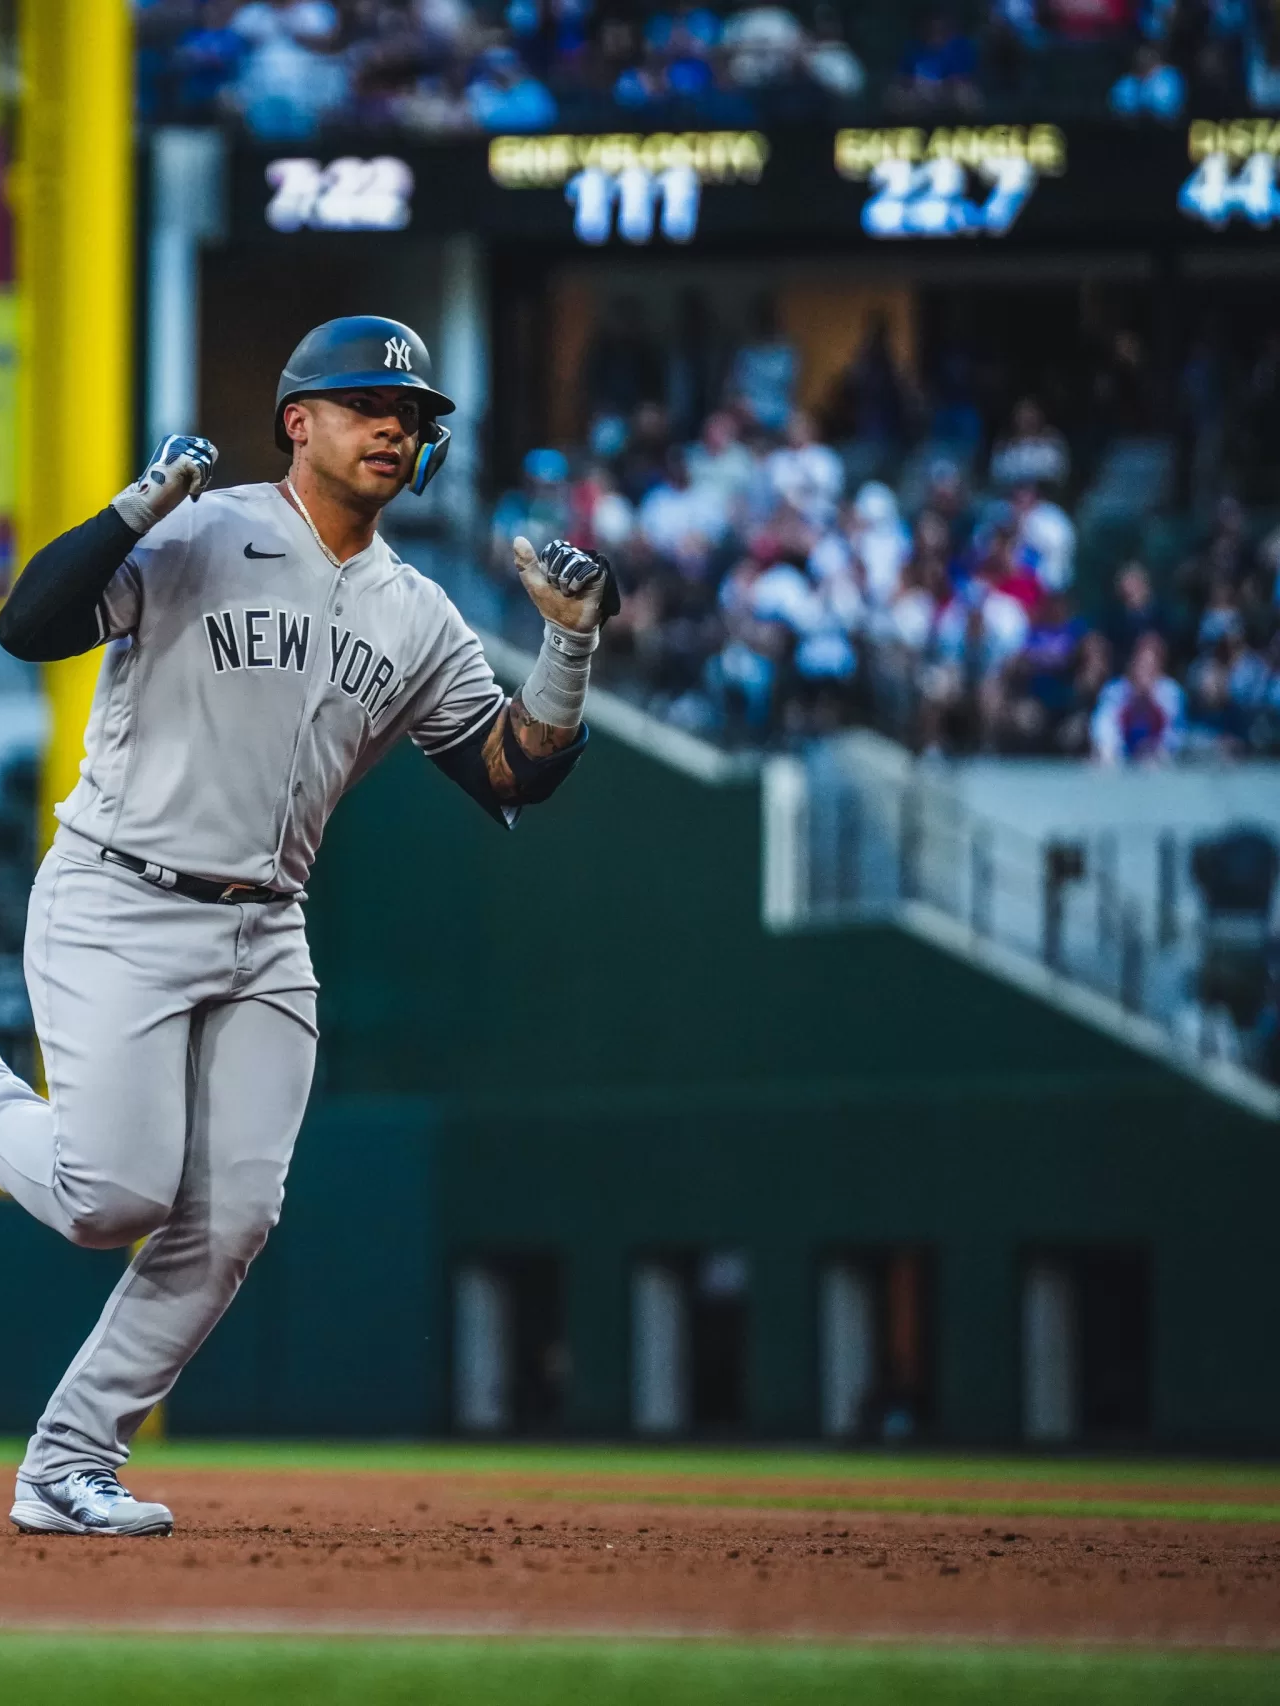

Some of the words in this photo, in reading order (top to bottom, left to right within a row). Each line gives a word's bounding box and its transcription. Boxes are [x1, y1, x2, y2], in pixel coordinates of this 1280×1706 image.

[565, 164, 699, 245] 111
[383, 336, 413, 372] NY
[202, 608, 312, 674] NEW
